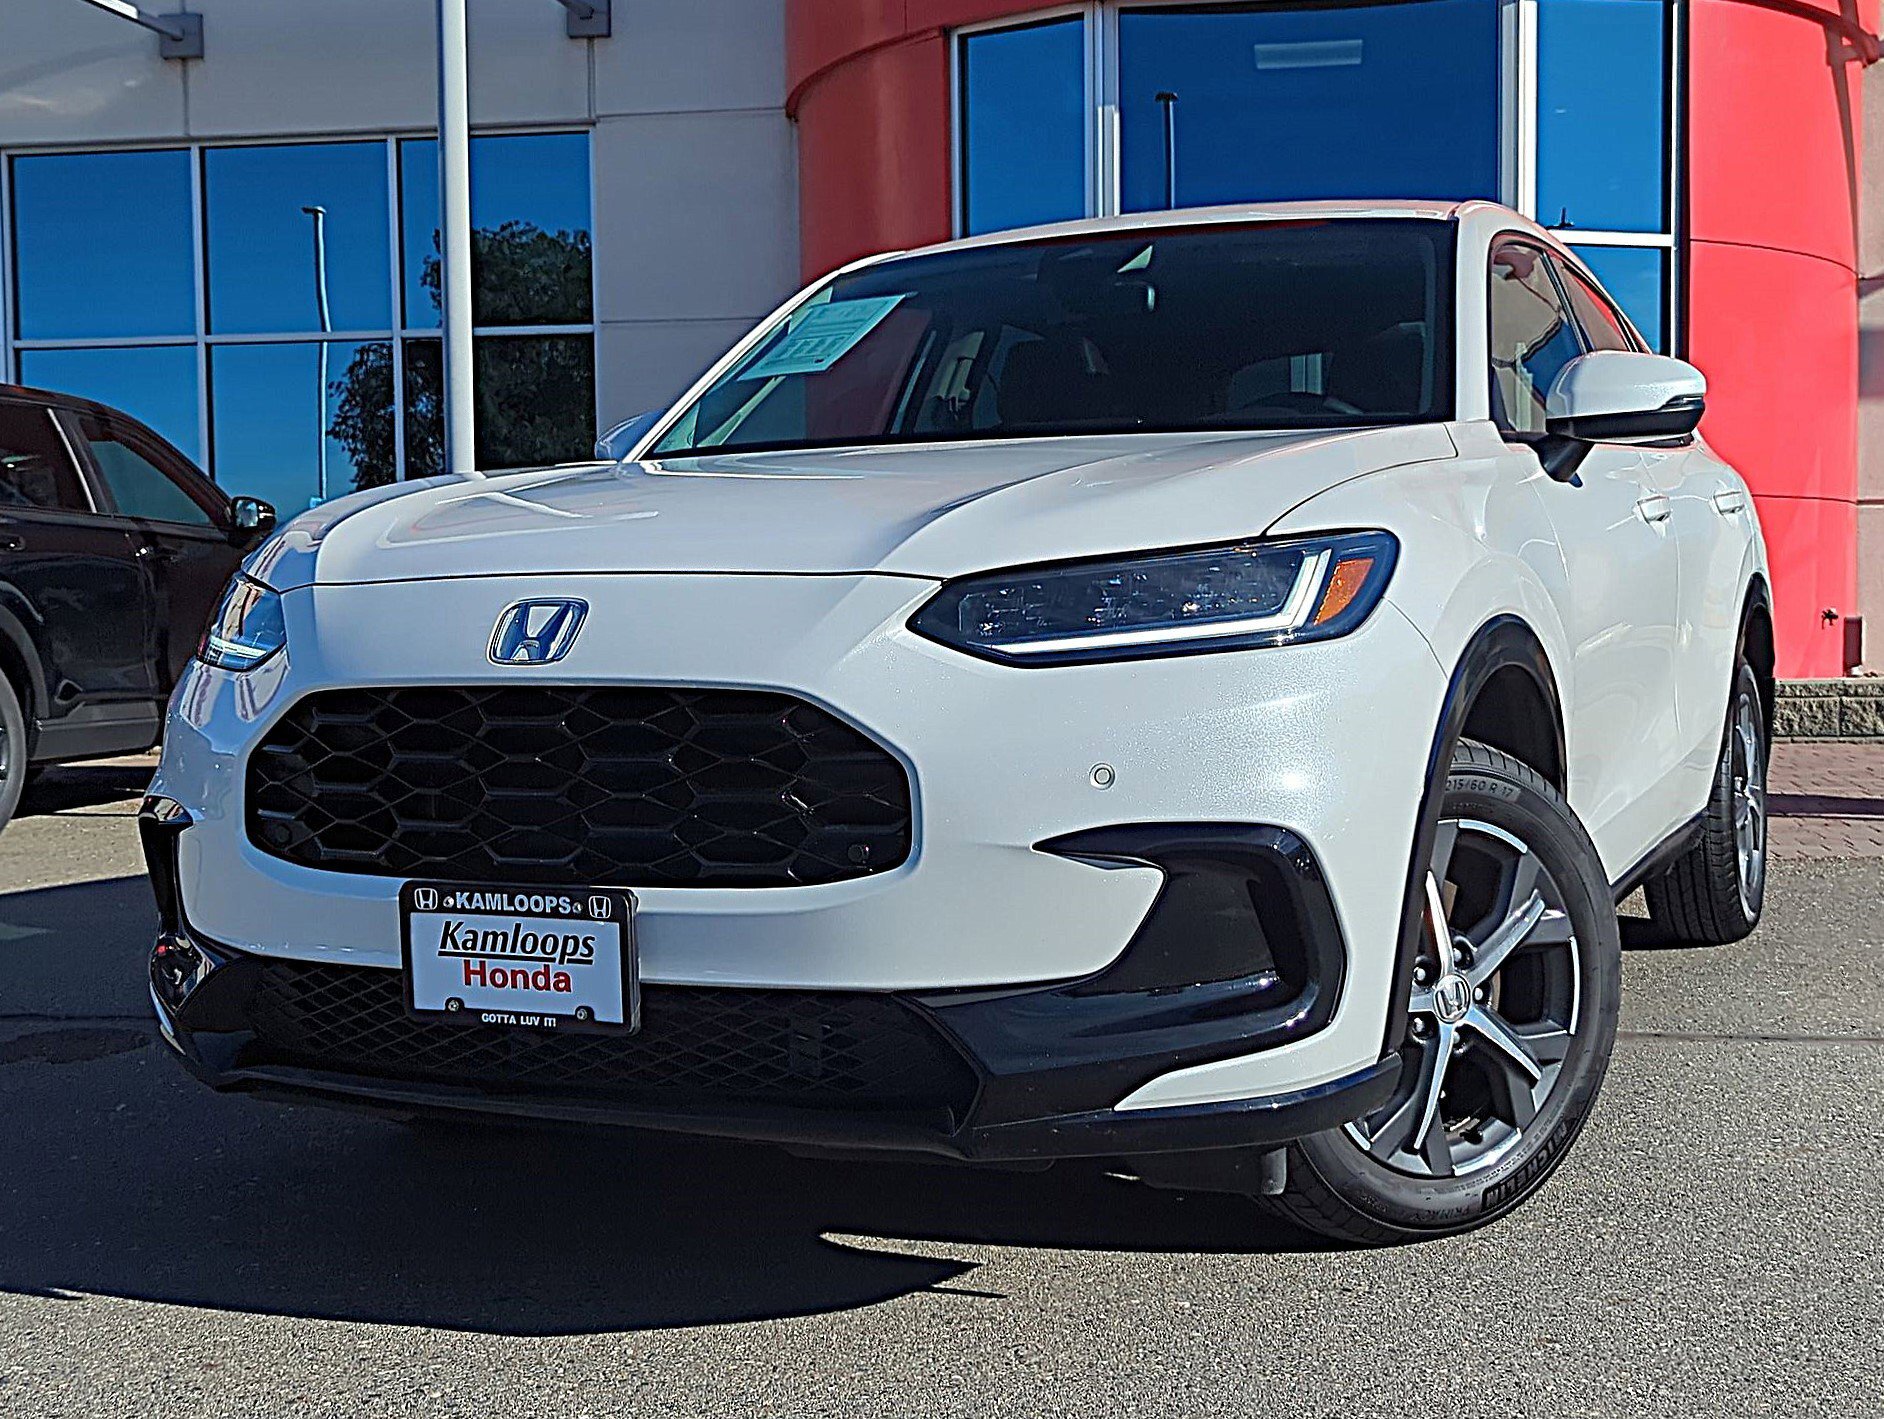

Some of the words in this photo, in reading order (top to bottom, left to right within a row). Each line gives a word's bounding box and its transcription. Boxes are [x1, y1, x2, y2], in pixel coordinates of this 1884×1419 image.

[1445, 779, 1486, 792] 215/60
[1488, 781, 1498, 794] R
[1499, 785, 1514, 798] 17
[455, 891, 571, 914] KAMLOOPS
[439, 920, 596, 966] Kamloops
[463, 959, 572, 993] Honda
[481, 1012, 517, 1025] GOTTA
[520, 1015, 540, 1026] LUV
[544, 1017, 557, 1028] IT!
[1485, 1121, 1568, 1209] MICHELIN
